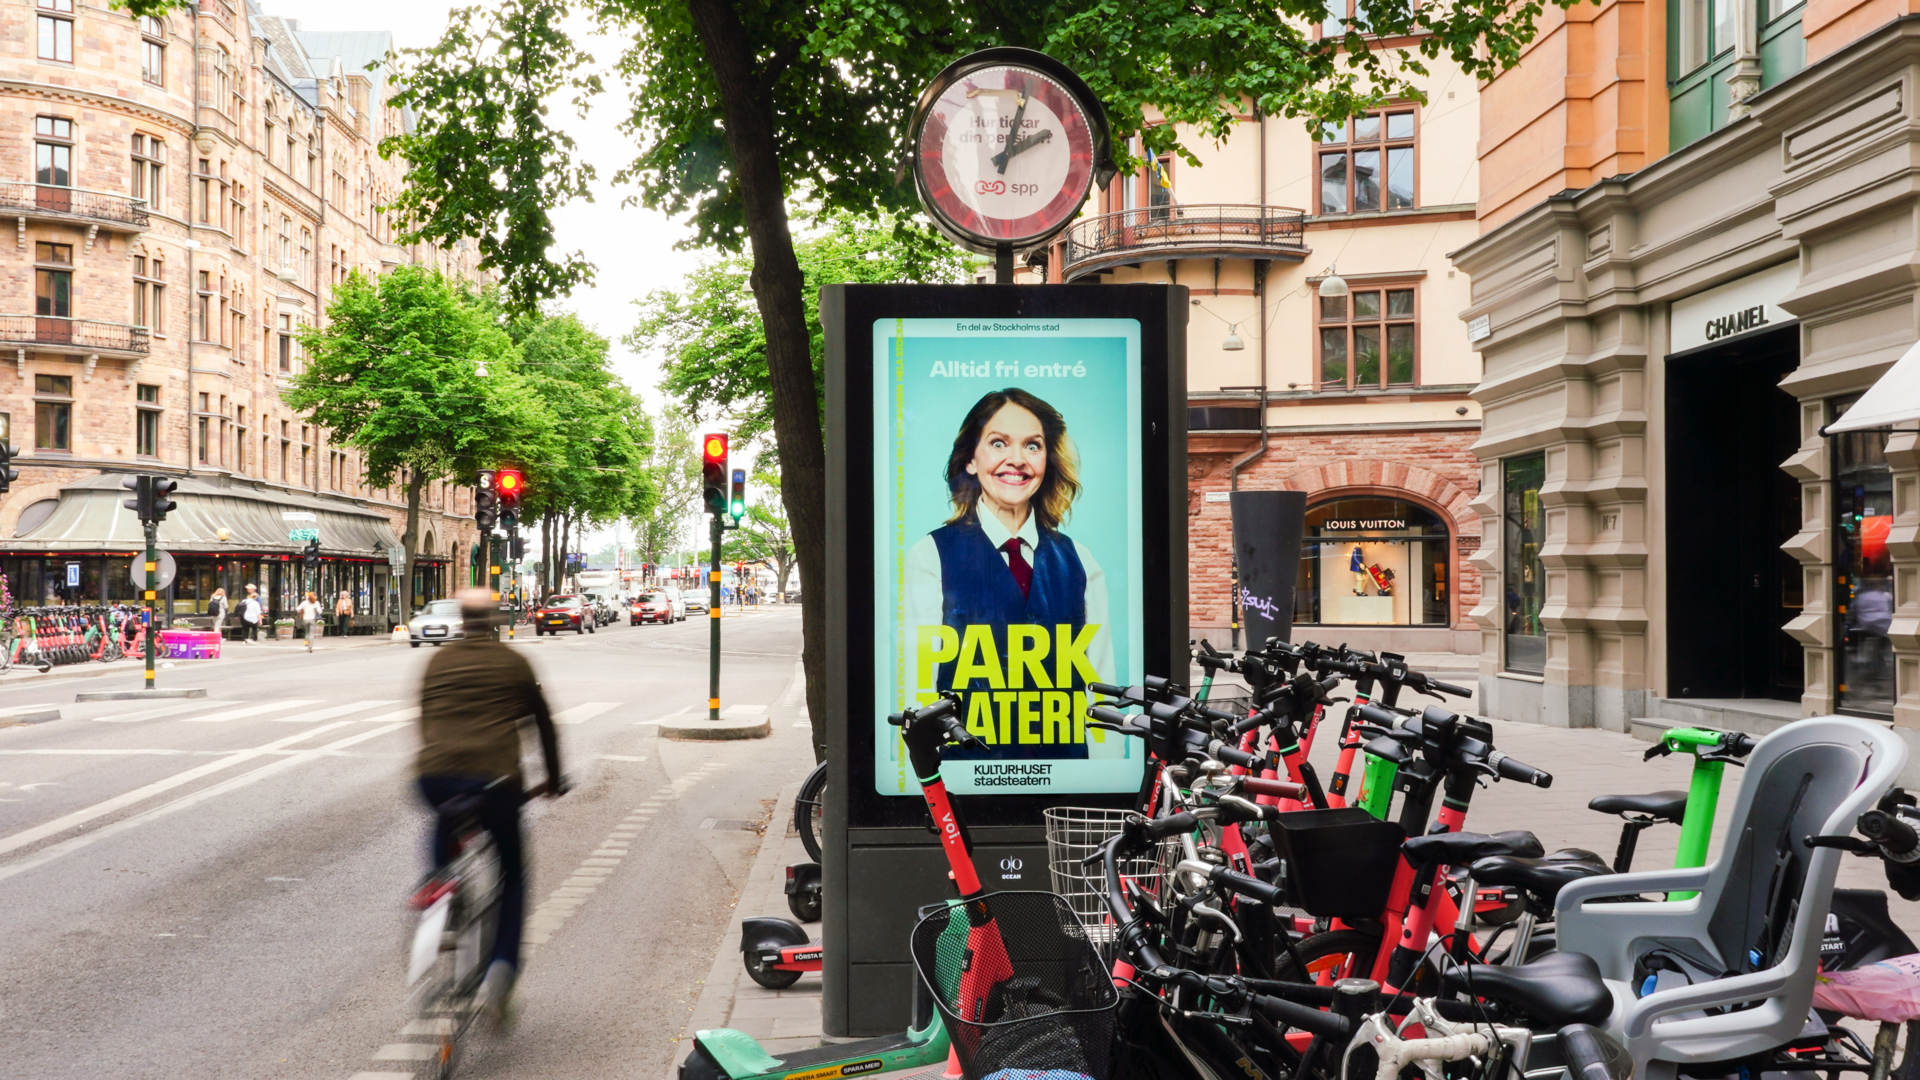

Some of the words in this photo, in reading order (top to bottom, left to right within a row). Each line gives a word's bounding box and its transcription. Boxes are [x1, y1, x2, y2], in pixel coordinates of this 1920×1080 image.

[970, 116, 996, 128] Hur
[960, 131, 982, 143] din
[986, 131, 1053, 146] pesi?
[1011, 183, 1039, 196] spp
[956, 323, 967, 331] En
[968, 323, 981, 331] del
[993, 323, 1041, 331] Stockholms
[1042, 323, 1060, 331] stad
[1705, 304, 1769, 341] CHANEL
[929, 360, 990, 378] Alltid
[994, 360, 1019, 378] fri
[1024, 360, 1087, 378] entré
[1326, 520, 1356, 529] LOUIS
[1359, 520, 1405, 529] VUITTON
[916, 623, 1104, 690] PARK
[916, 690, 1106, 745] ATERN
[974, 764, 1052, 775] KULTURHUSET
[974, 776, 1051, 786] stadsteatern
[942, 812, 960, 844] voi.
[795, 952, 818, 960] FÖRSTA
[816, 1070, 838, 1078] SMART
[843, 1064, 864, 1074] SPARA
